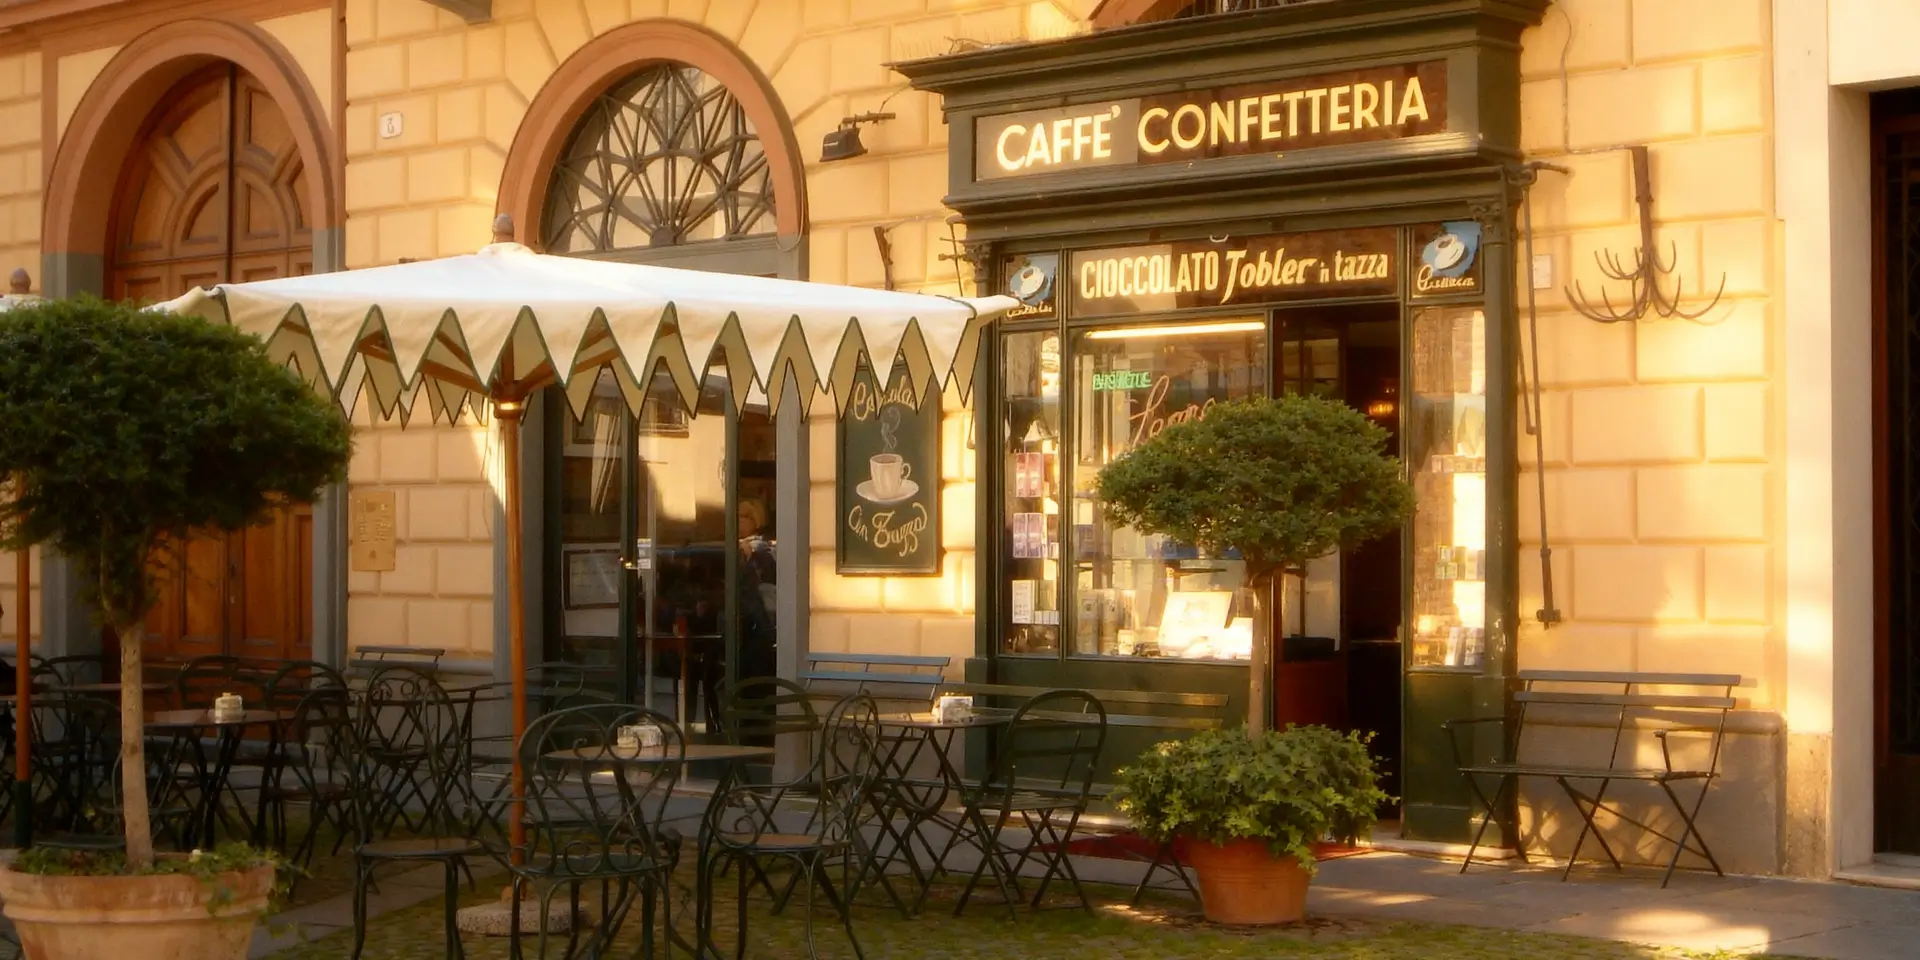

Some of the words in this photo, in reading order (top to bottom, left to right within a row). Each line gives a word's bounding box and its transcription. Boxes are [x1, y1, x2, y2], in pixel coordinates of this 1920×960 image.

[1137, 76, 1430, 155] CONFETTERIA
[1080, 250, 1220, 300] CIOCCOLATO
[1222, 247, 1317, 304] Tobler
[1334, 249, 1389, 282] tazza
